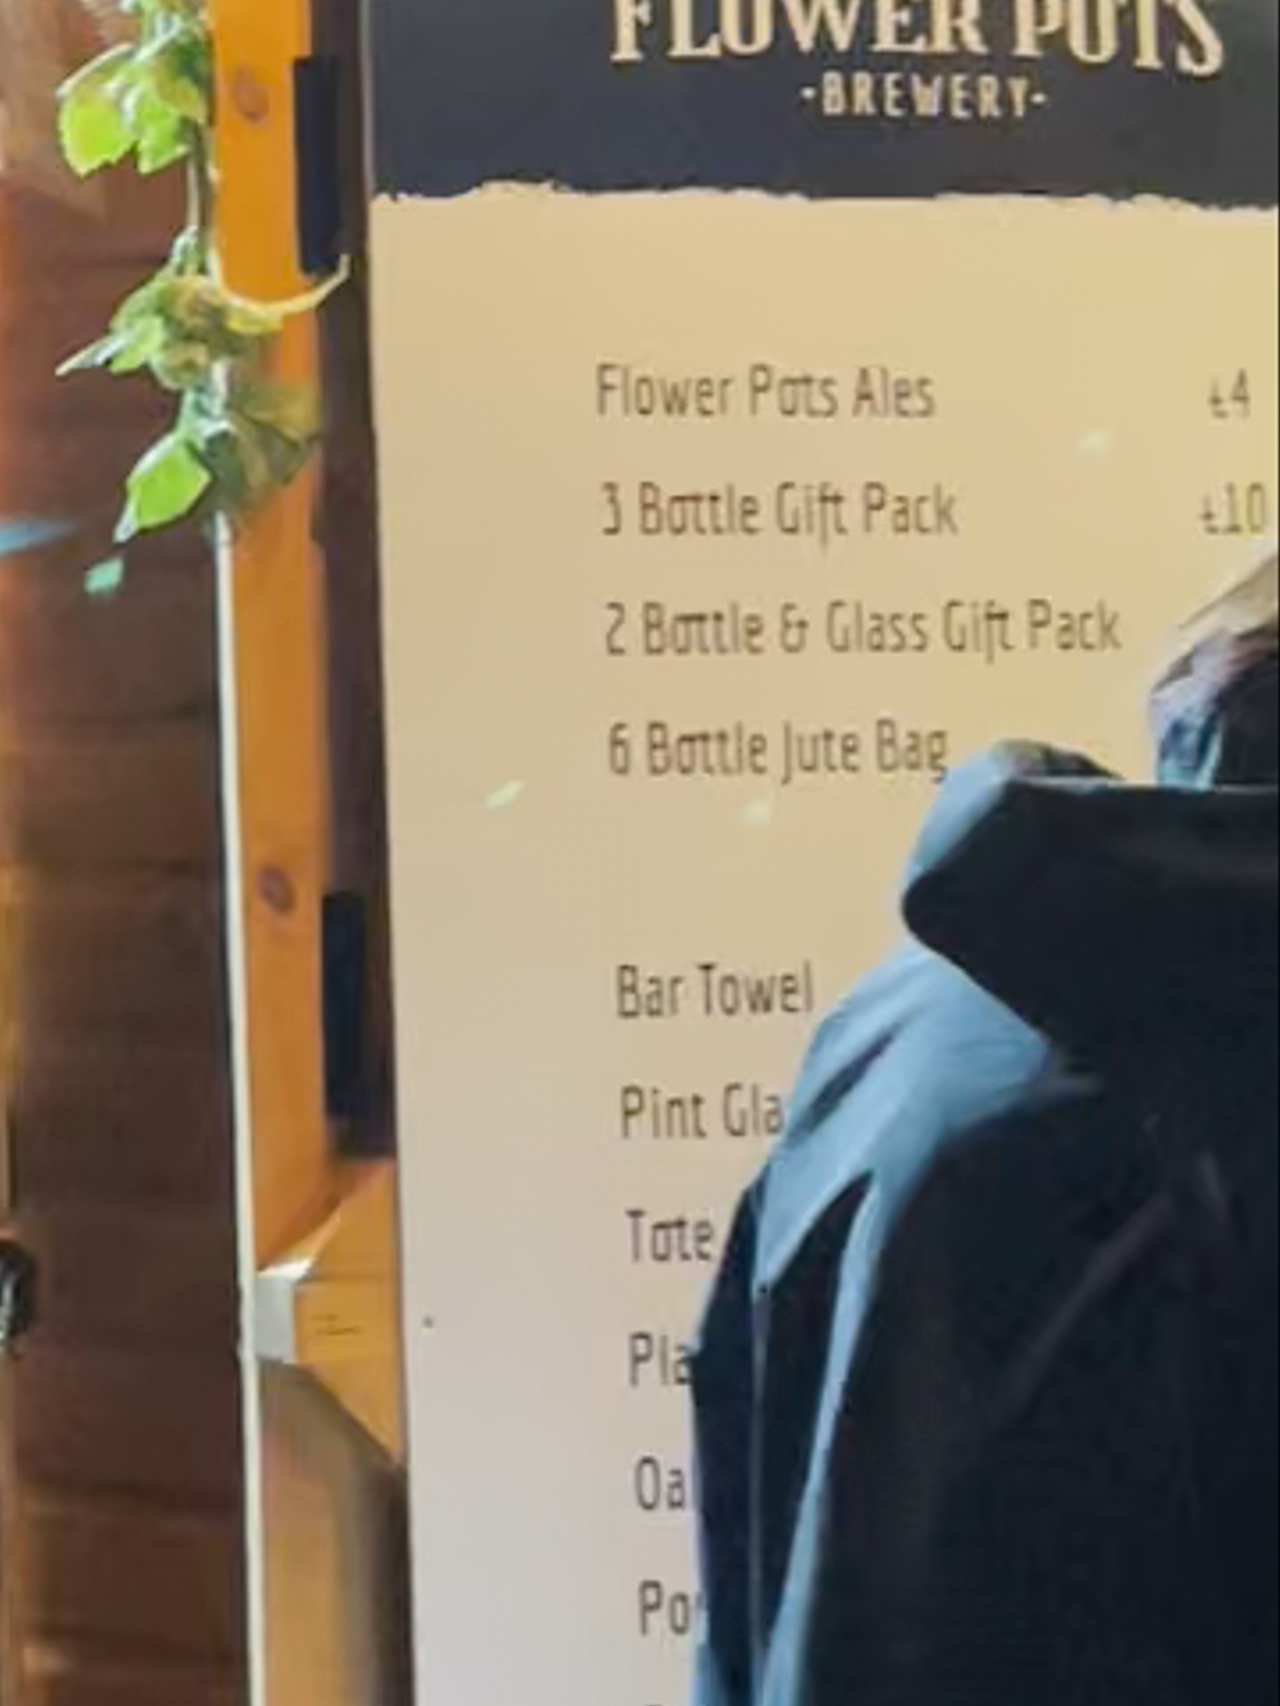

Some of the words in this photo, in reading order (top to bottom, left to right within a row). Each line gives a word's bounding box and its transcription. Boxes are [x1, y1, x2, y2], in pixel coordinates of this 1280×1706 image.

[822, 70, 1031, 118] BREWERY
[597, 364, 731, 417] Flower
[748, 364, 839, 416] Pots
[852, 364, 935, 417] Ales
[602, 481, 622, 536] 3
[640, 481, 759, 535] Bottle
[776, 481, 848, 551] Gift
[863, 481, 960, 534] Pack
[605, 601, 625, 655] 2
[645, 601, 765, 654] Bottle
[780, 600, 808, 653] &
[826, 600, 928, 652] Glass
[942, 599, 1015, 666] Gift
[1028, 598, 1124, 650] Pack
[609, 722, 630, 775] 6
[648, 720, 768, 775] Bottle
[782, 720, 860, 783] Jute
[876, 718, 948, 784] Bag
[617, 963, 684, 1018] Bar
[697, 960, 814, 1016] Towel
[621, 1086, 707, 1139] Pint
[625, 1210, 714, 1263] Tote
